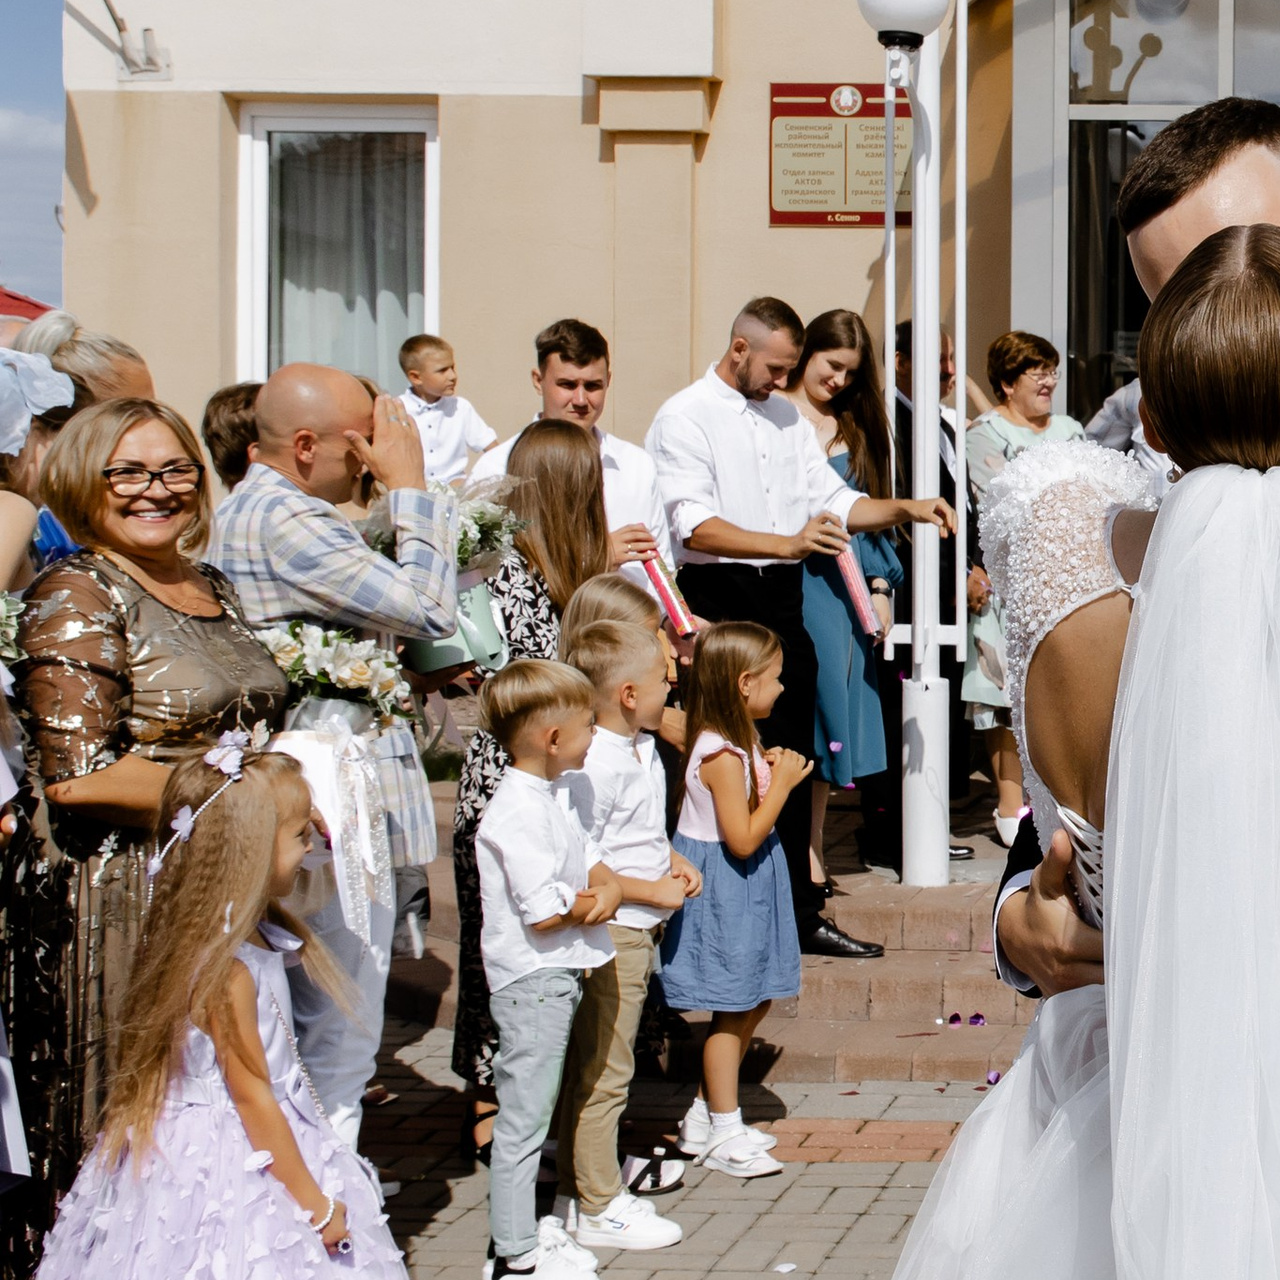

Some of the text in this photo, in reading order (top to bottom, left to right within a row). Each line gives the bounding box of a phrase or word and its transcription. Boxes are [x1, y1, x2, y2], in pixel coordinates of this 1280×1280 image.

[784, 123, 833, 131] Сенненский
[787, 132, 830, 142] районный
[774, 141, 843, 150] исполнительный
[782, 169, 806, 177] Отдел
[781, 189, 836, 197] гражданского
